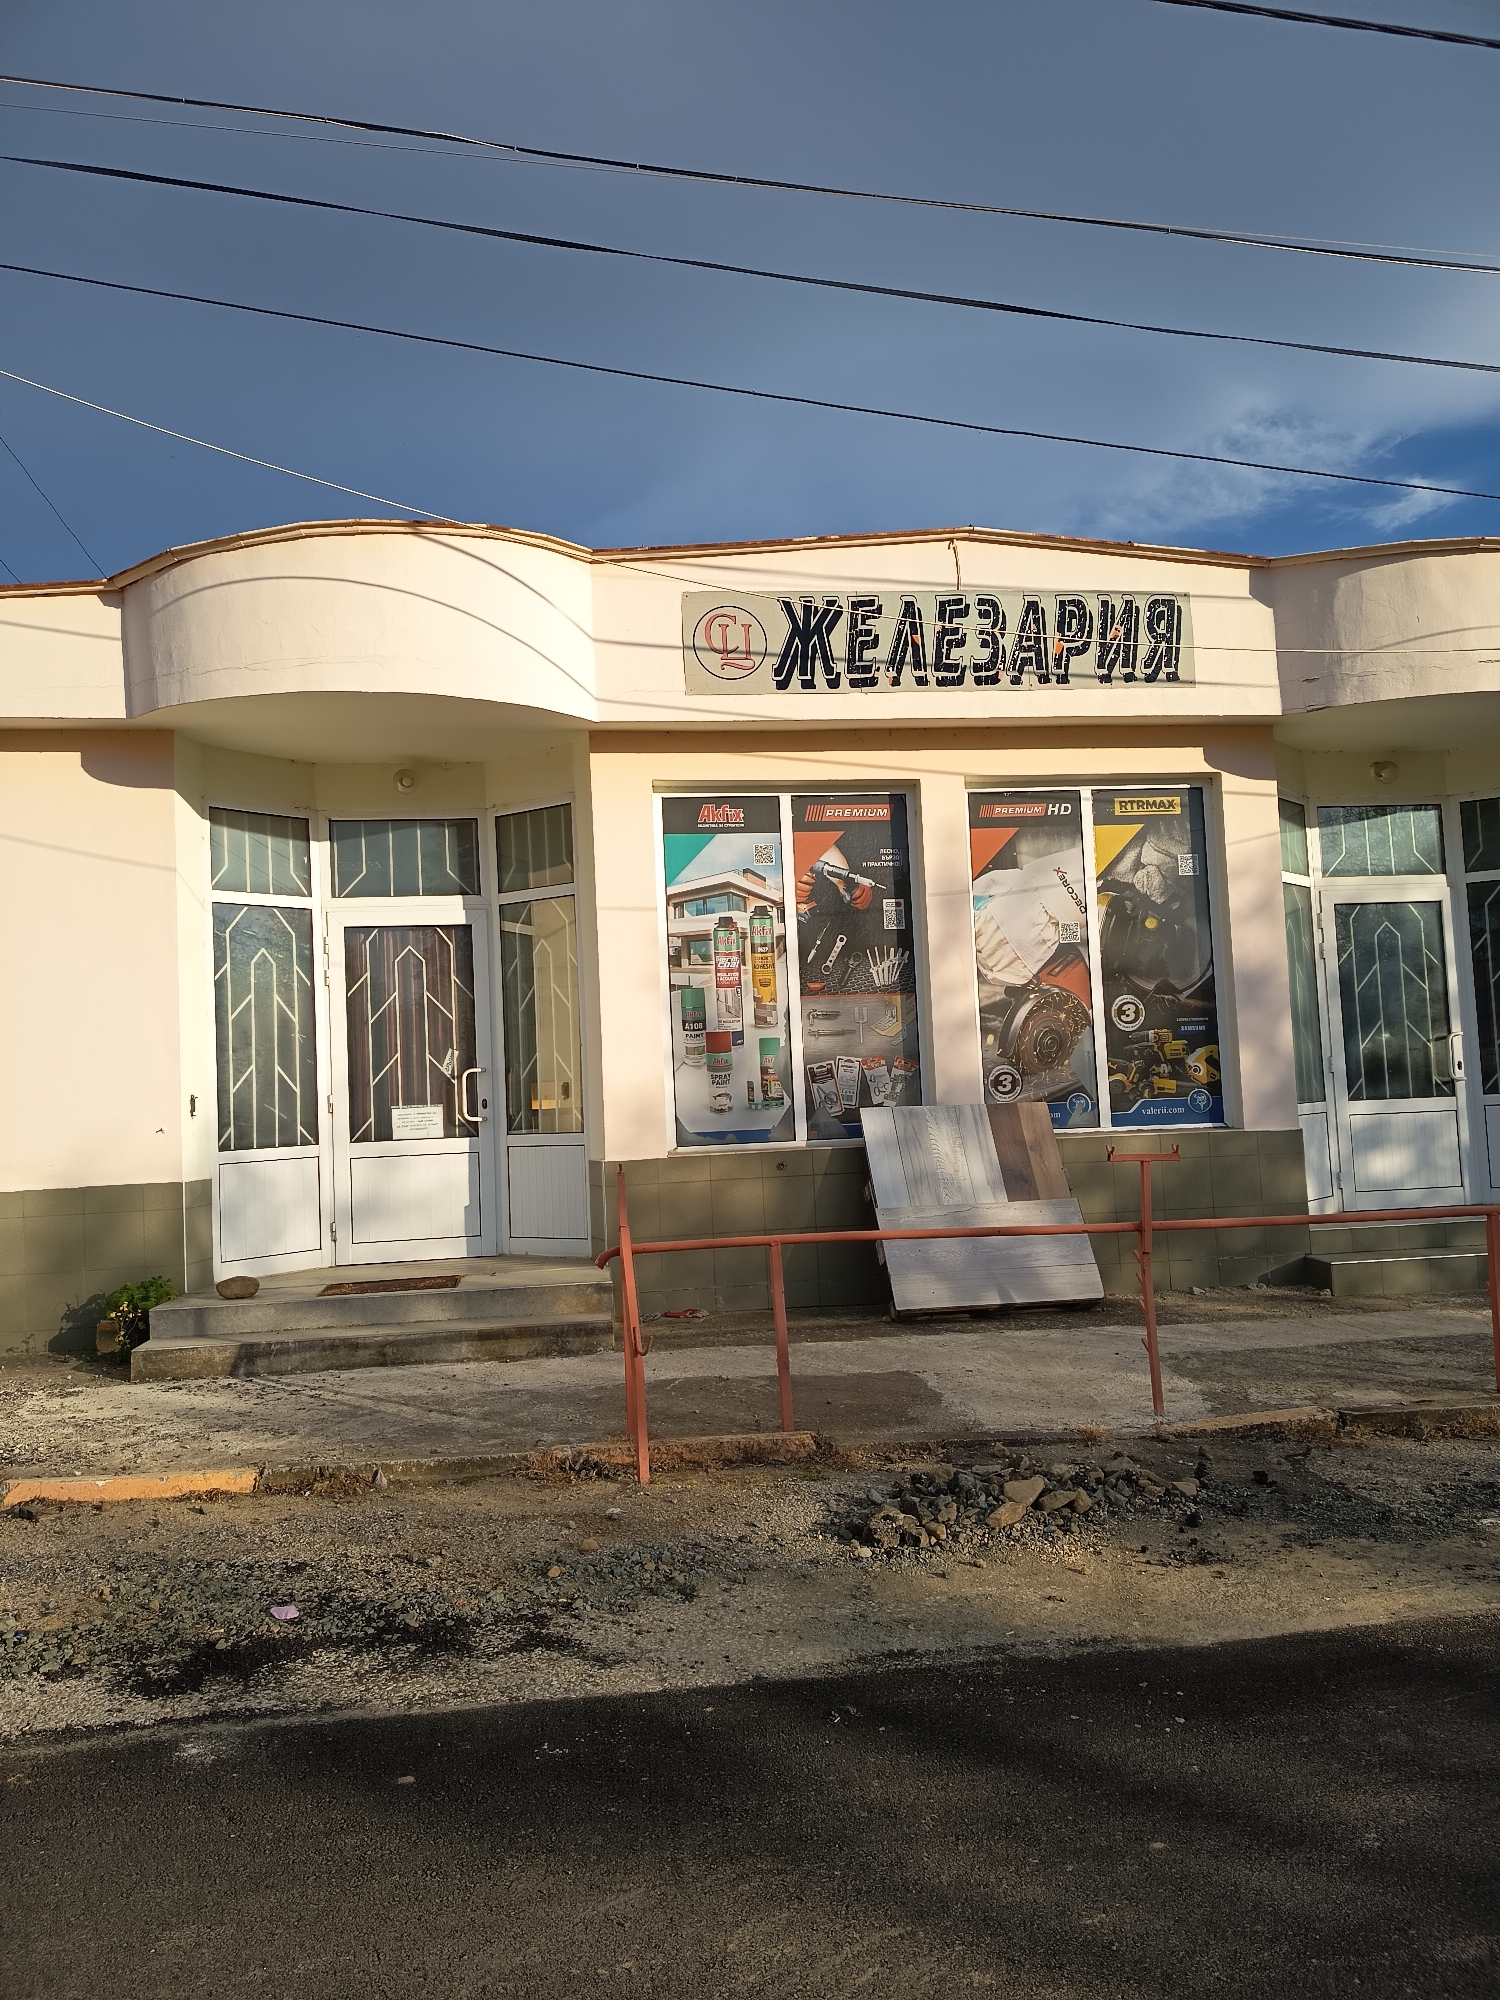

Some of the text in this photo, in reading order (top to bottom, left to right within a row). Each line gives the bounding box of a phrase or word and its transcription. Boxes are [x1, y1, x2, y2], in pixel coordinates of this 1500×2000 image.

[771, 594, 1181, 690] ЖЕЛЕЗАРИЯ
[994, 803, 1072, 815] PREMIUM HD
[1118, 799, 1177, 811] RTRMAX
[698, 804, 744, 822] Akfix
[825, 808, 888, 817] PREMIUM
[1052, 866, 1087, 915] DECOREX
[1120, 1003, 1137, 1022] 3
[684, 1022, 703, 1030] A108
[763, 1056, 775, 1064] Akf
[997, 1074, 1013, 1092] 3
[1141, 1106, 1185, 1115] valerii.com
